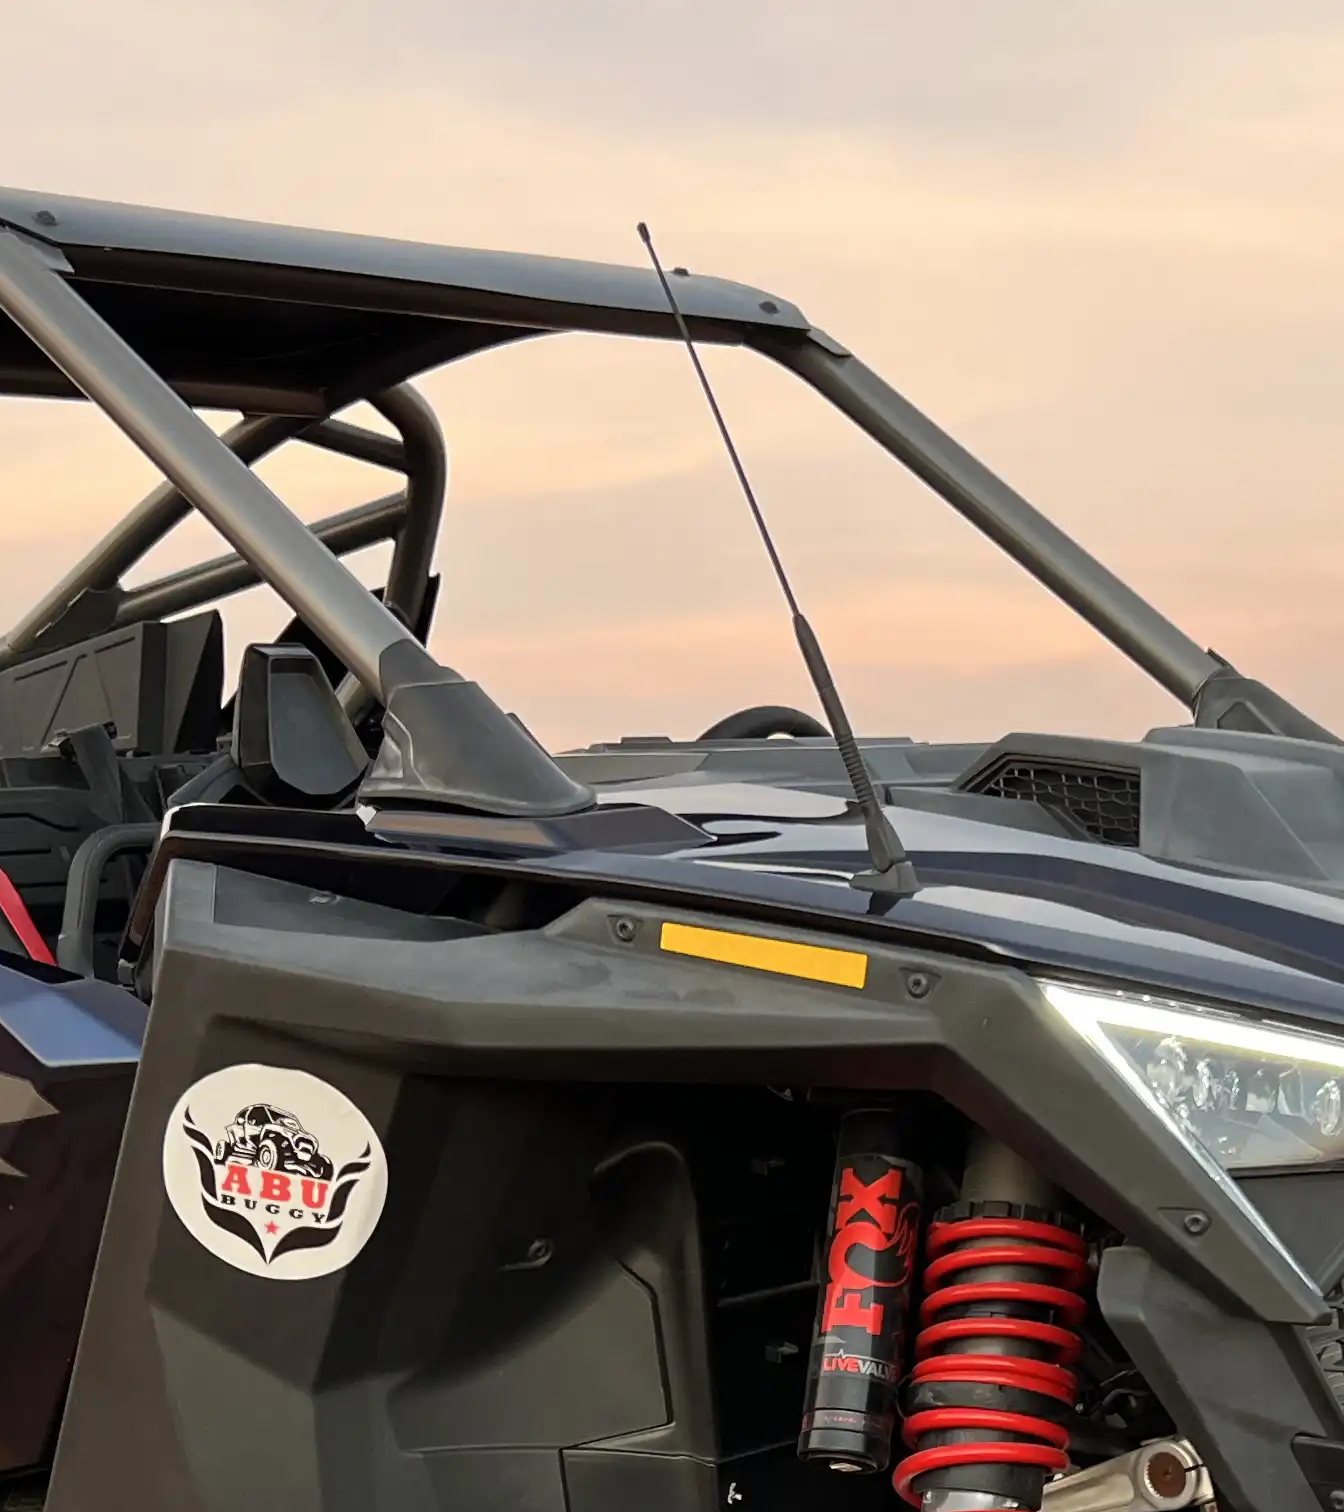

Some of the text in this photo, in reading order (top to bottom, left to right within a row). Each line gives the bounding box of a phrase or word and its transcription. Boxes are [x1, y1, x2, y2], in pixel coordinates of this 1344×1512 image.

[220, 1163, 329, 1209] ABU
[220, 1193, 326, 1224] BUGGY
[821, 1167, 918, 1335] FOX
